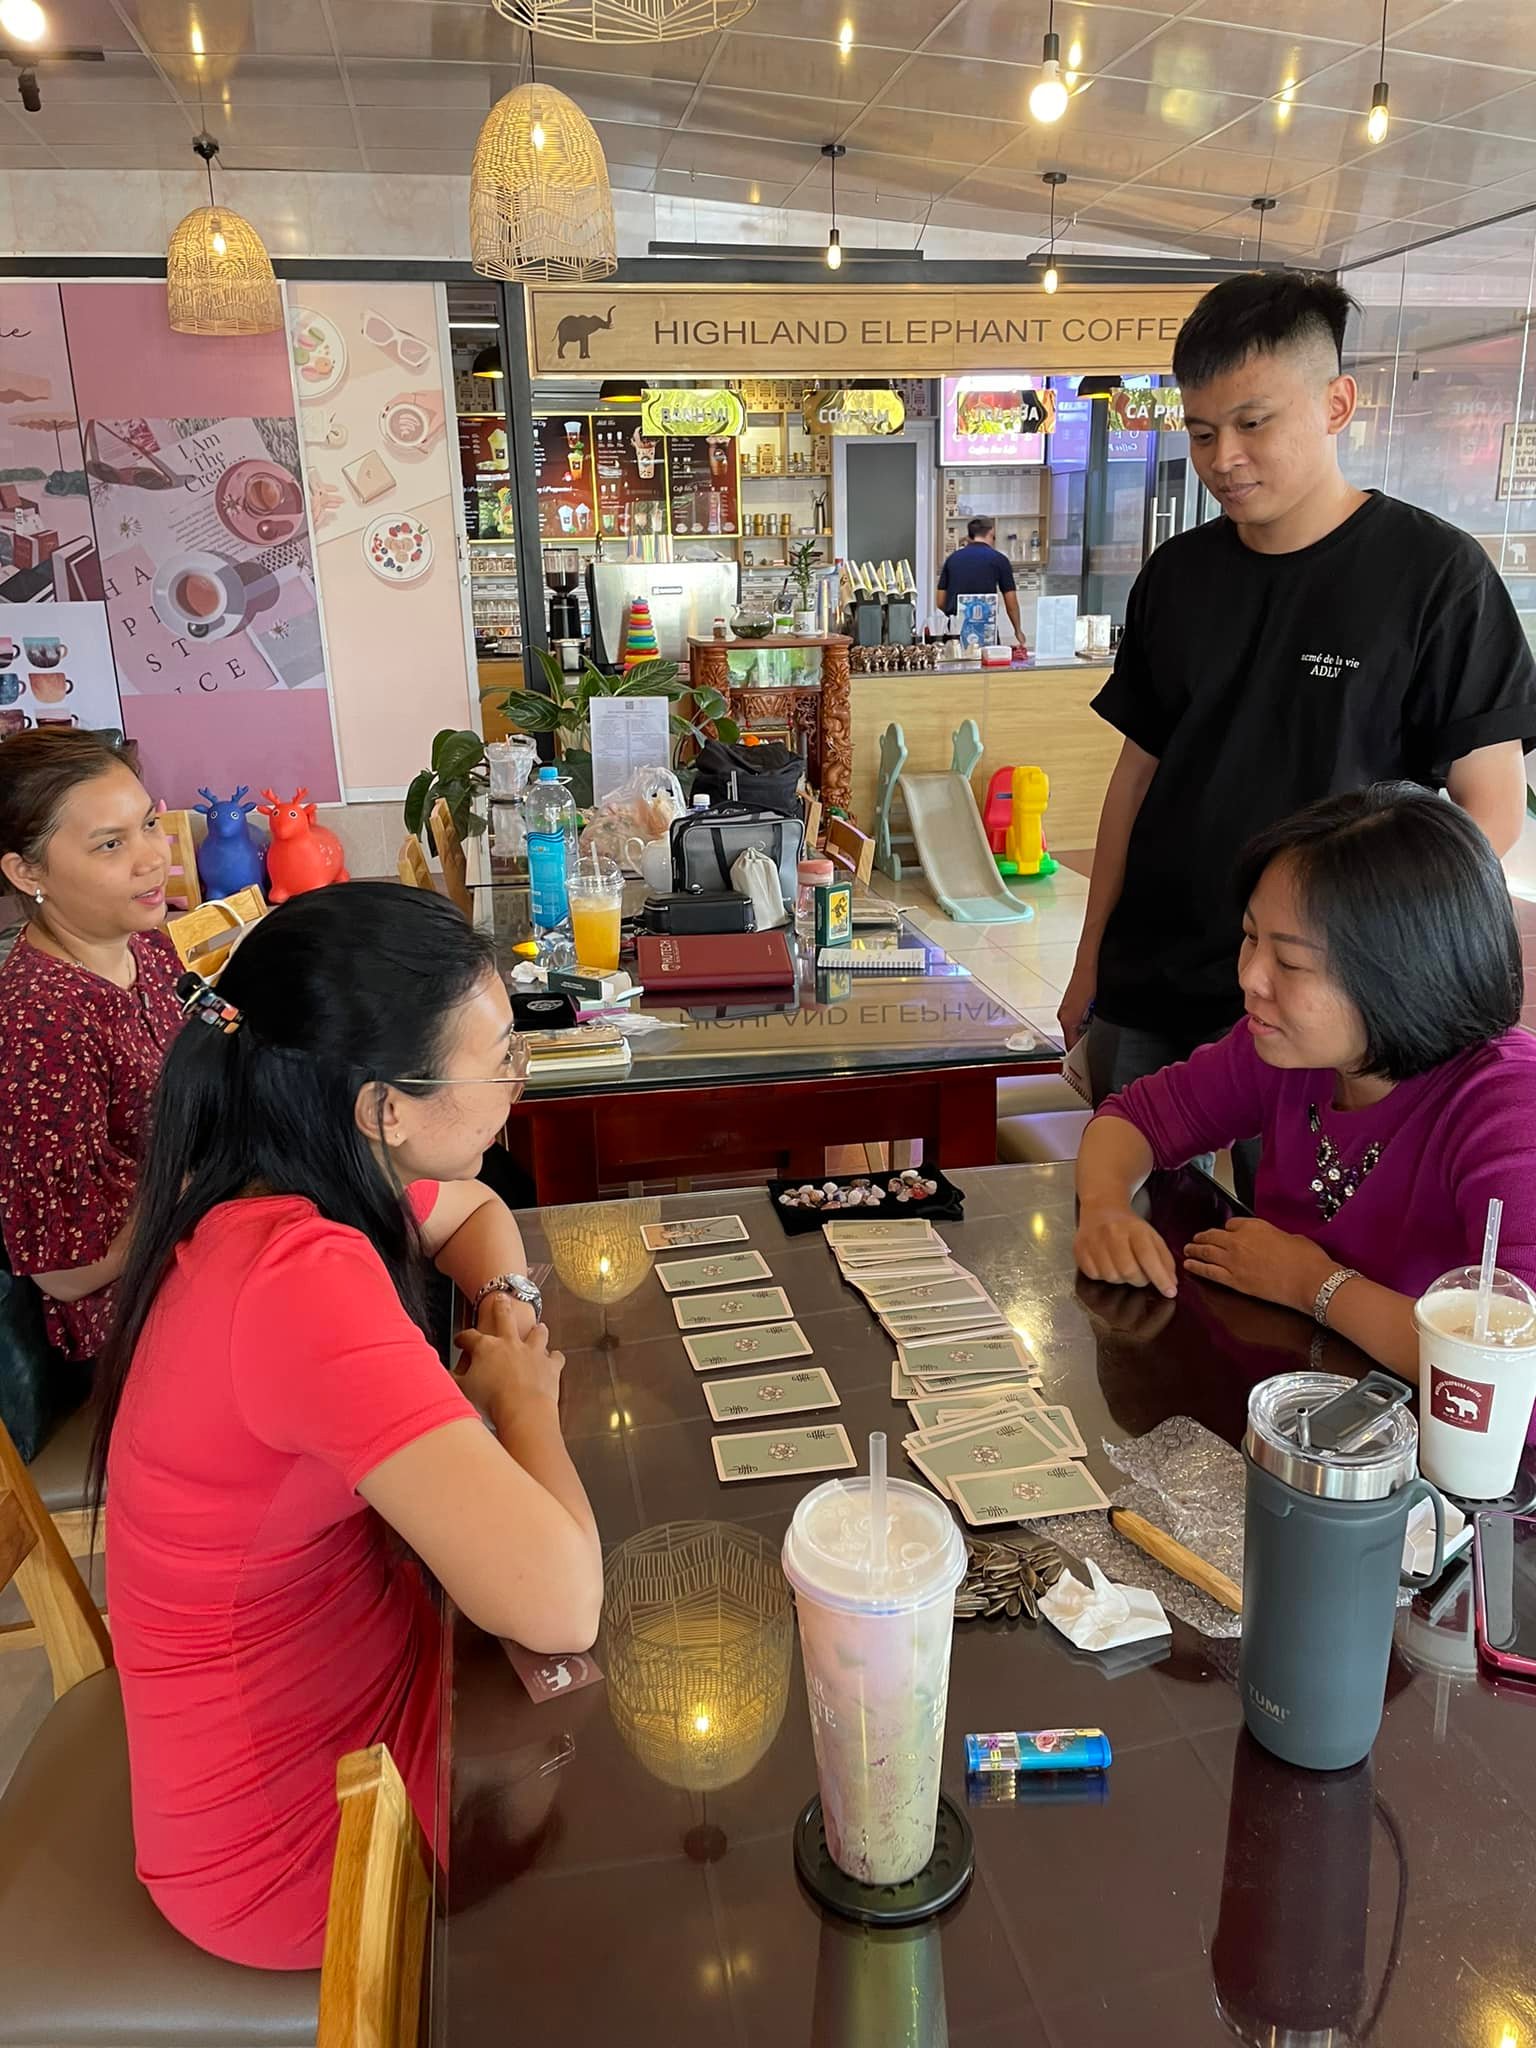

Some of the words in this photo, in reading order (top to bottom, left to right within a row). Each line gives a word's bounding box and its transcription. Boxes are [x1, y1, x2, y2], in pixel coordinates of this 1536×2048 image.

[654, 320, 848, 345] HIGHLAND
[861, 319, 1052, 344] ELEPHANT
[1062, 317, 1188, 342] COFFE
[1345, 657, 1360, 669] vie
[1247, 1680, 1286, 1720] TUMI
